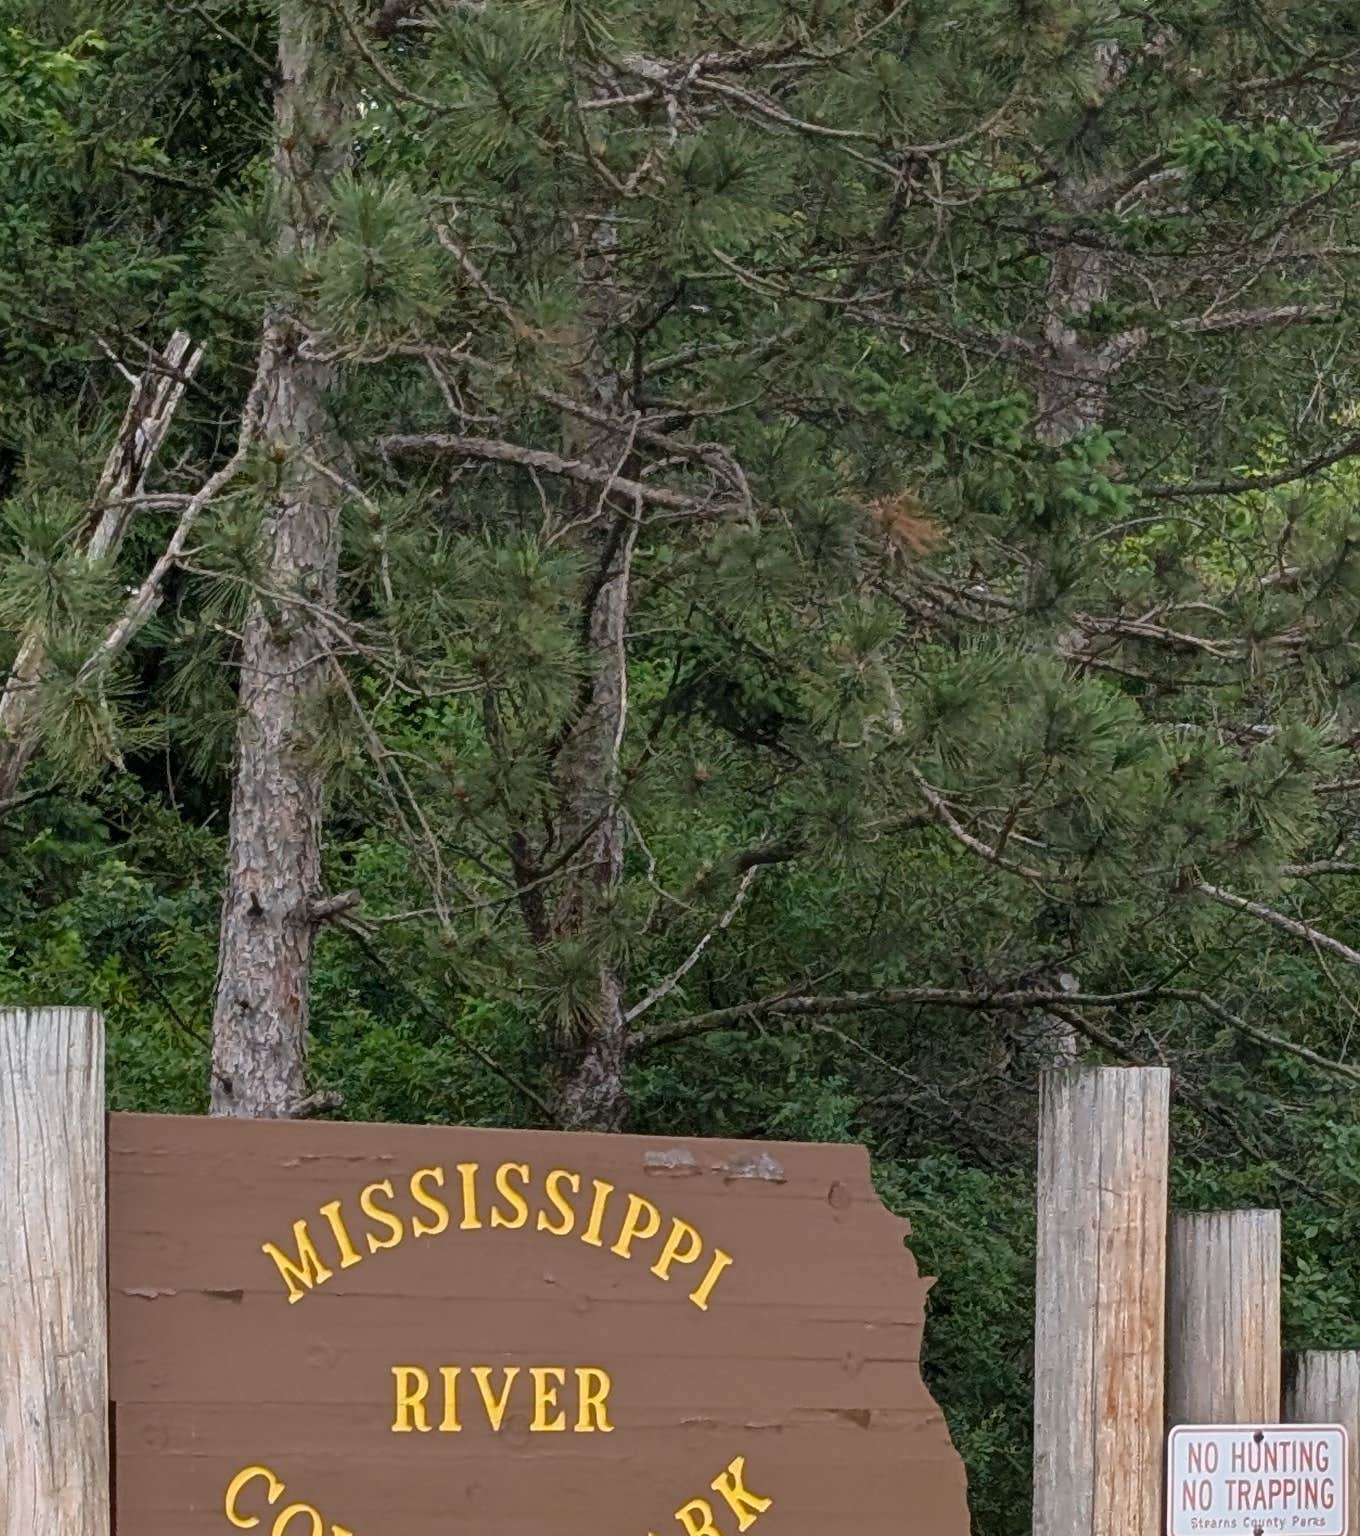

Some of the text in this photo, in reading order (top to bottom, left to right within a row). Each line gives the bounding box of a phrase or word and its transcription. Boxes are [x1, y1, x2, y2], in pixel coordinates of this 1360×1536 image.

[261, 1161, 734, 1311] MISSISSIPPI
[391, 1365, 615, 1433] RIVER
[1188, 1441, 1329, 1473] NO HUNTING
[1183, 1478, 1334, 1511] NO TRAPPING
[1191, 1516, 1237, 1530] Stearns
[1243, 1516, 1286, 1531] County
